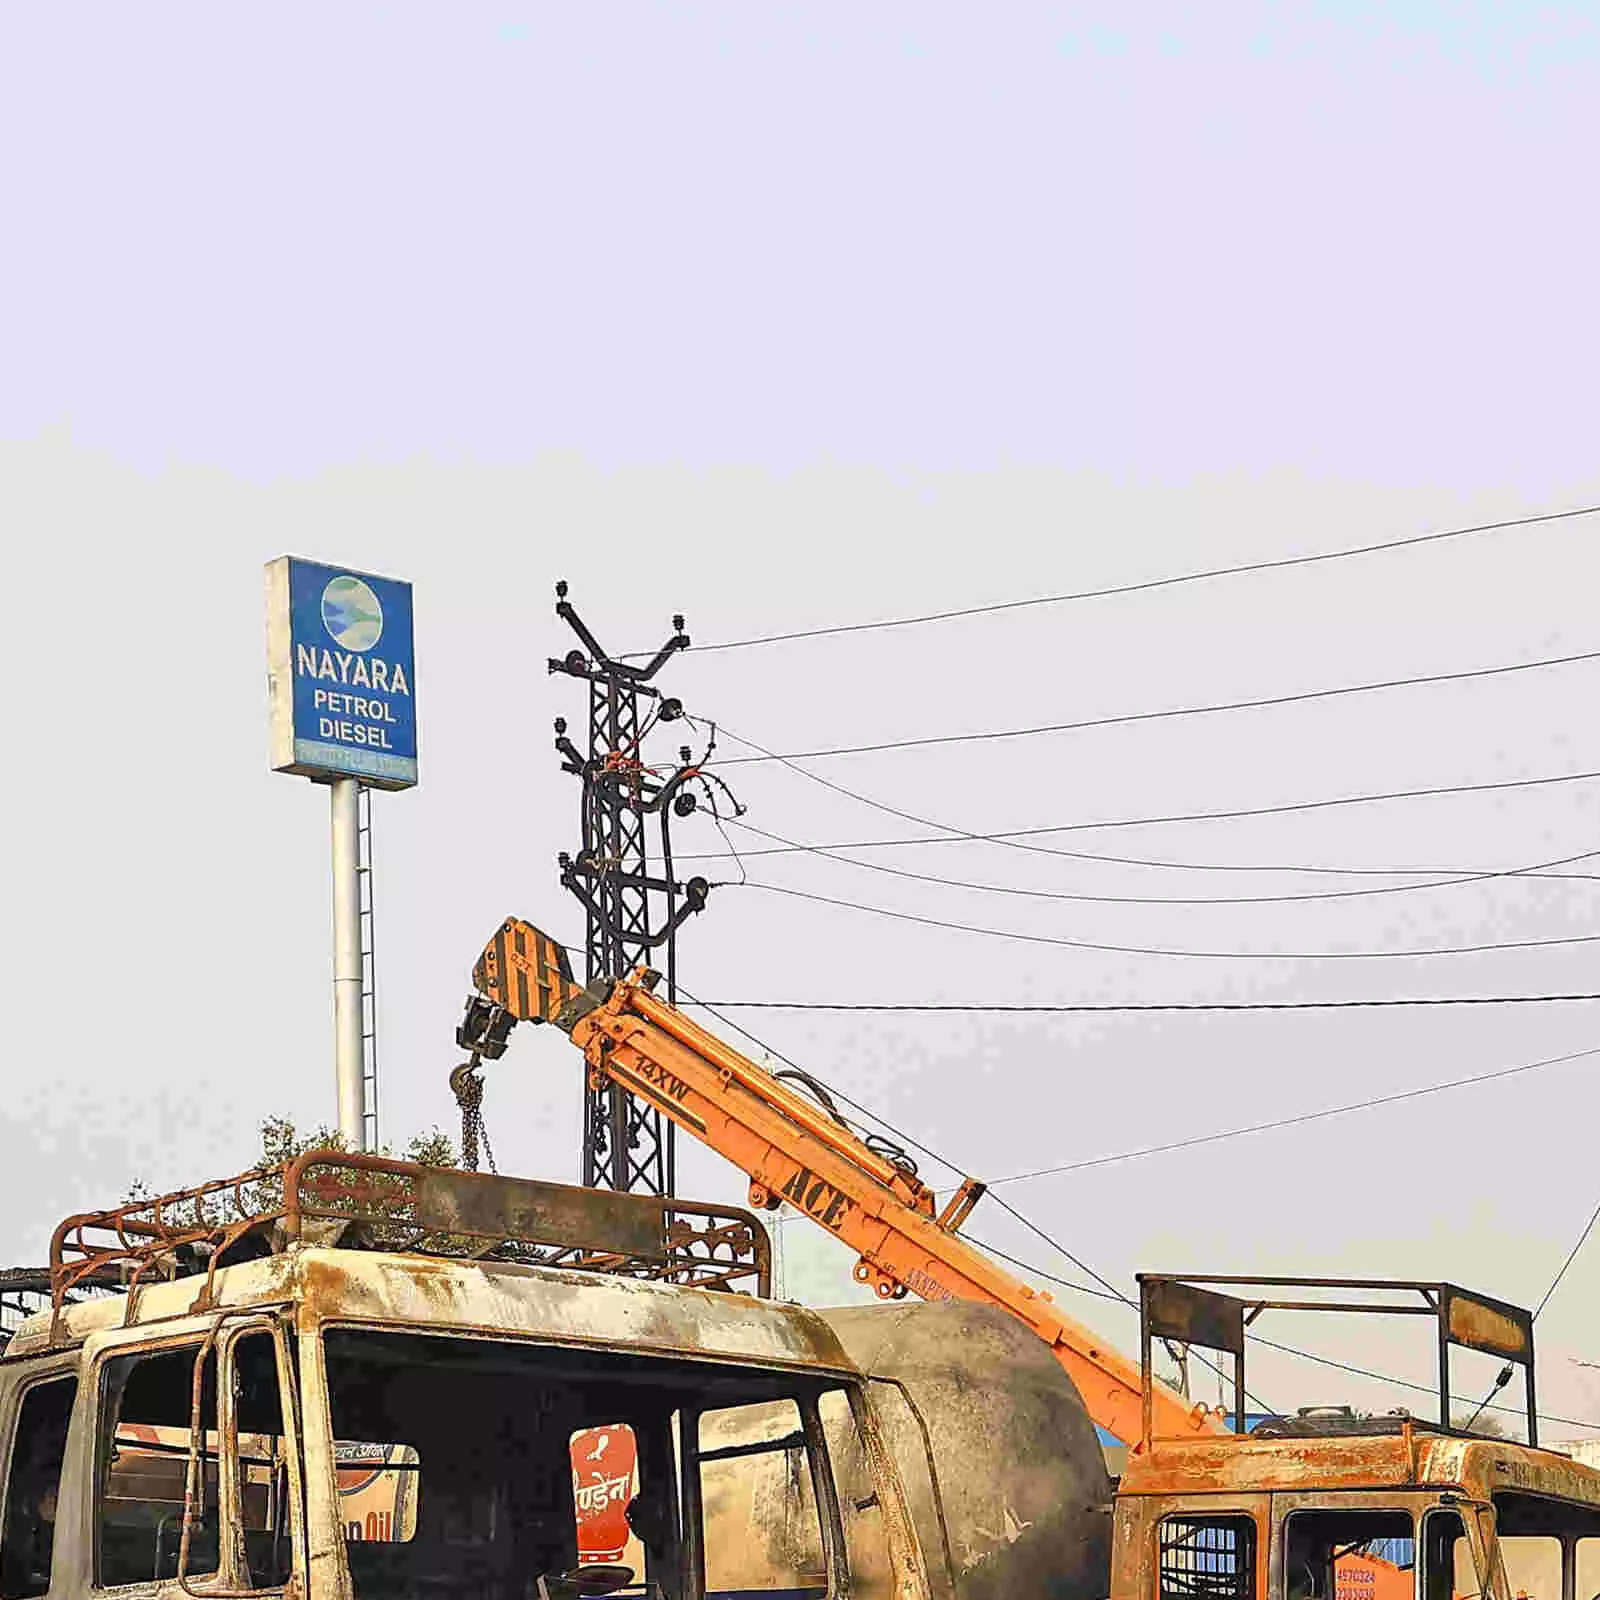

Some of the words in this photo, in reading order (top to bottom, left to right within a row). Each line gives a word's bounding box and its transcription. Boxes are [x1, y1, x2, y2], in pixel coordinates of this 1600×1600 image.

[297, 643, 410, 696] NAYARA
[314, 688, 396, 722] PETROL
[320, 717, 393, 749] DIESEL
[633, 1055, 689, 1101] 14XW
[782, 1167, 857, 1232] ACE
